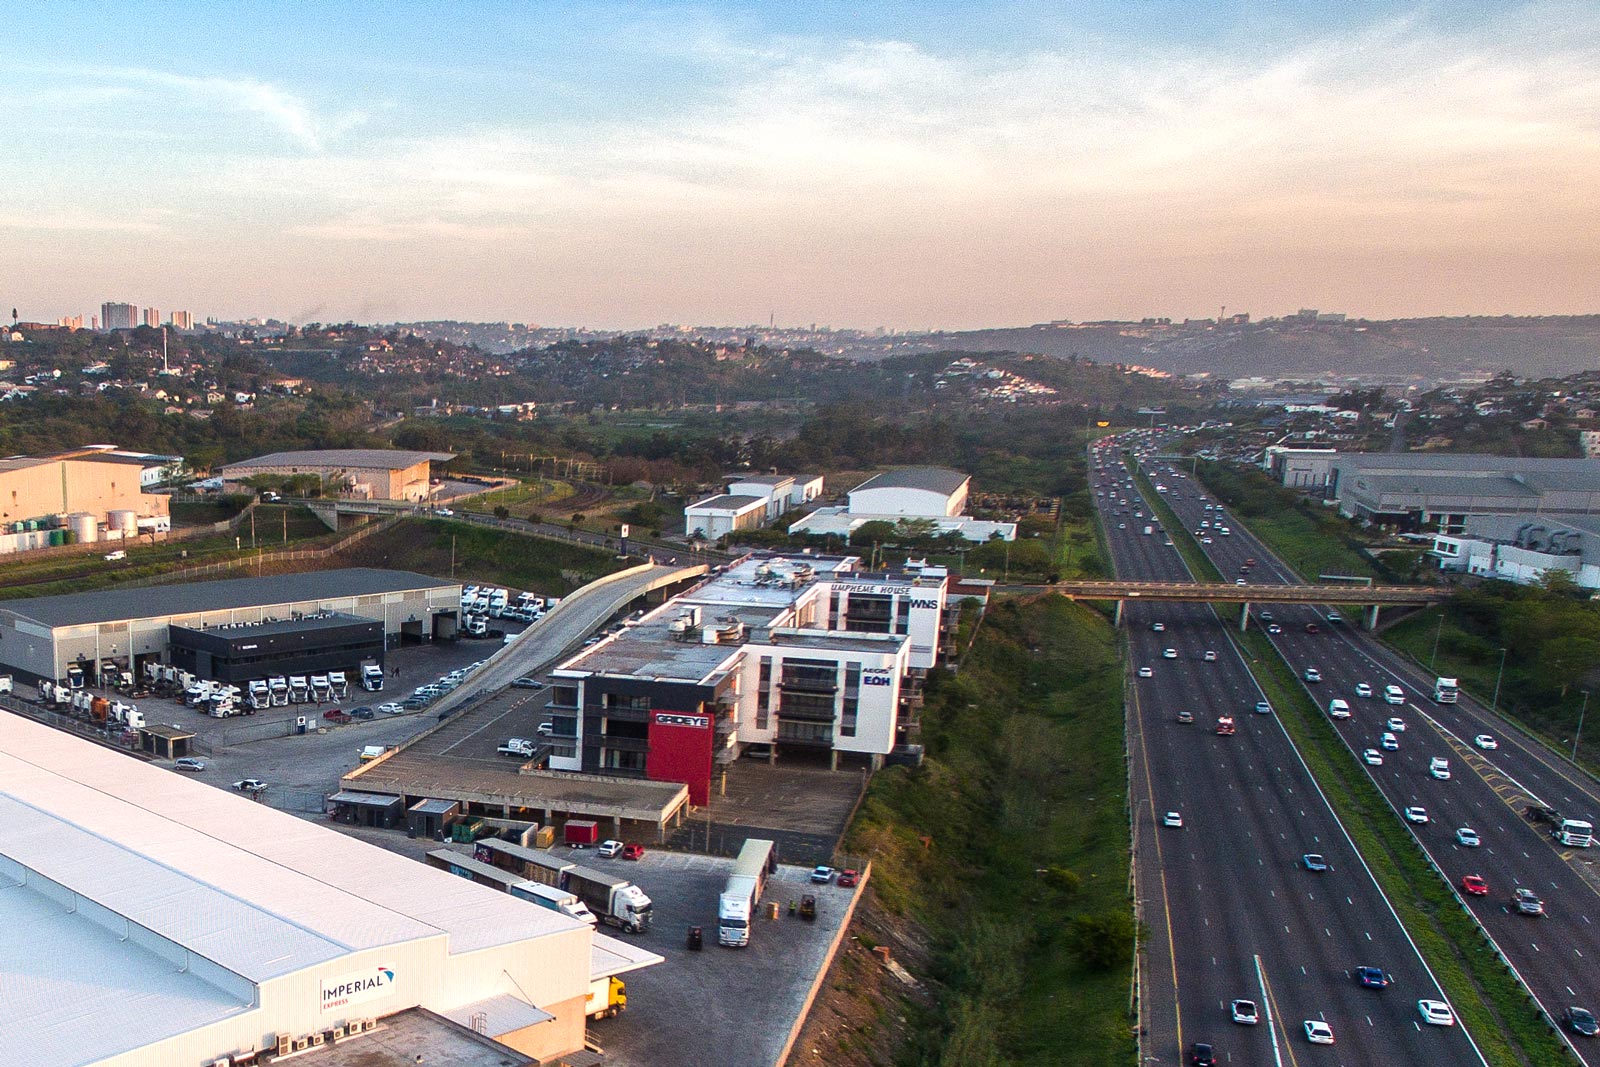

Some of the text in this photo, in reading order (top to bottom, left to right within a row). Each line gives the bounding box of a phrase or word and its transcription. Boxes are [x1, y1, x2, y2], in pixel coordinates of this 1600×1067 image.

[911, 599, 938, 609] WNS
[864, 676, 890, 686] EOH
[657, 715, 708, 726] GRIDEYE
[323, 975, 383, 1001] IMPERIAL
[323, 998, 349, 1010] EXPRESS
